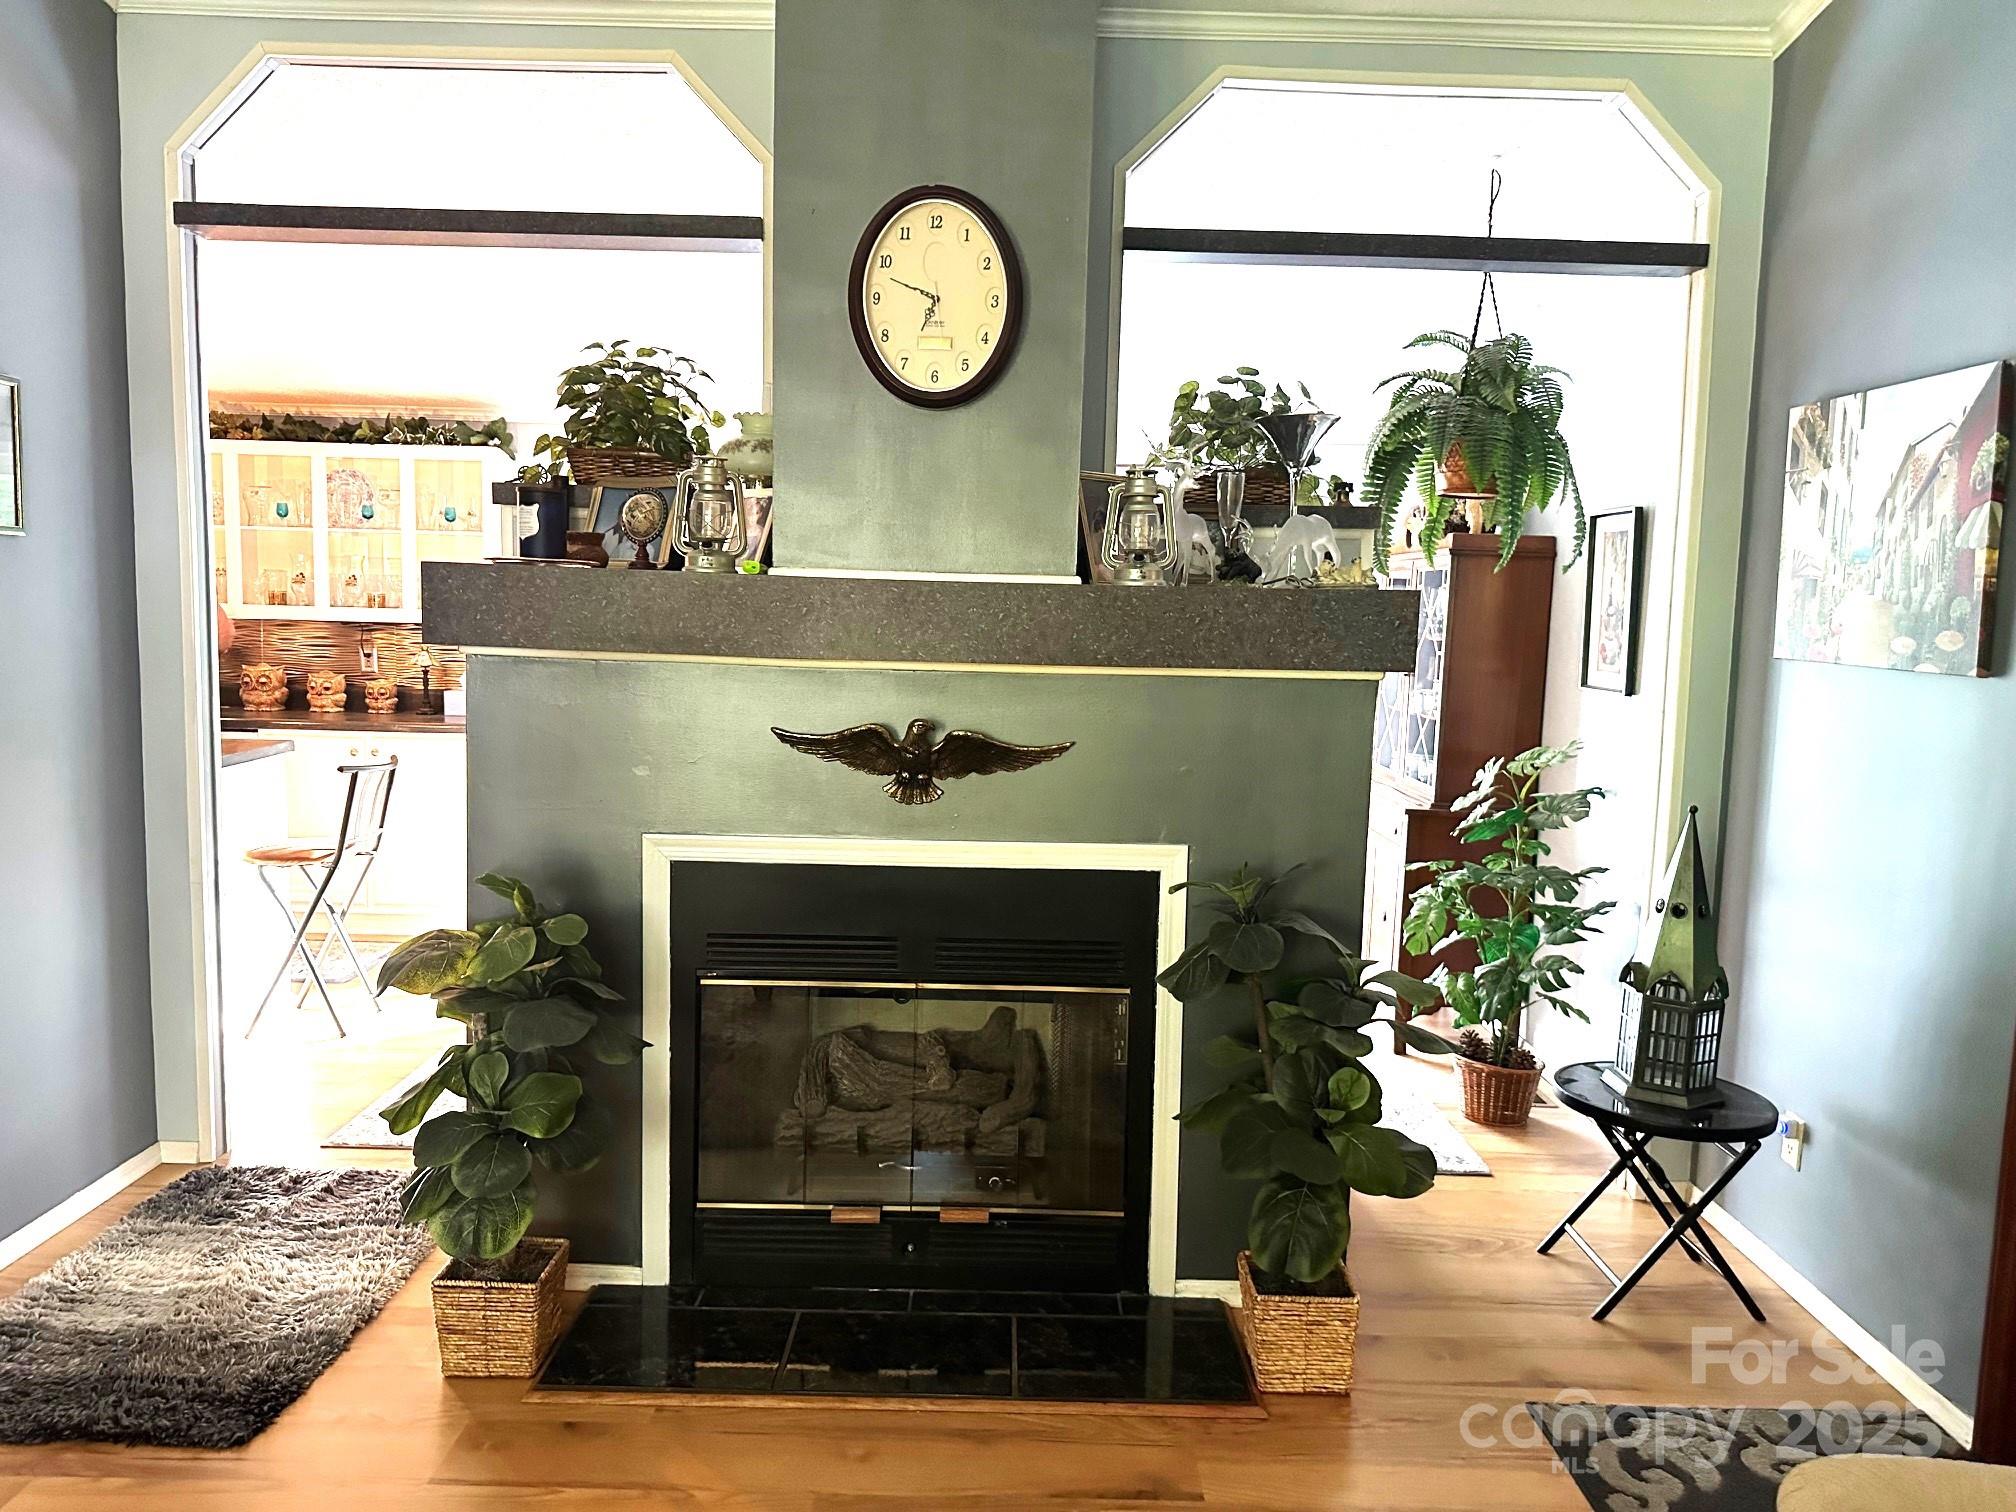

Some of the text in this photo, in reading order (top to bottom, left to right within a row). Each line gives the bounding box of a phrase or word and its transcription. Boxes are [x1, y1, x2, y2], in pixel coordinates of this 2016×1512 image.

[930, 215, 943, 229] 12
[899, 227, 911, 240] 11
[964, 228, 970, 242] 1
[879, 255, 892, 269] 10
[983, 257, 991, 270] 2
[872, 292, 881, 305] 9
[990, 294, 999, 308] 3
[881, 328, 889, 342] 8
[981, 331, 989, 345] 4
[900, 357, 909, 370] 7
[961, 358, 969, 372] 5
[931, 370, 939, 383] 6
